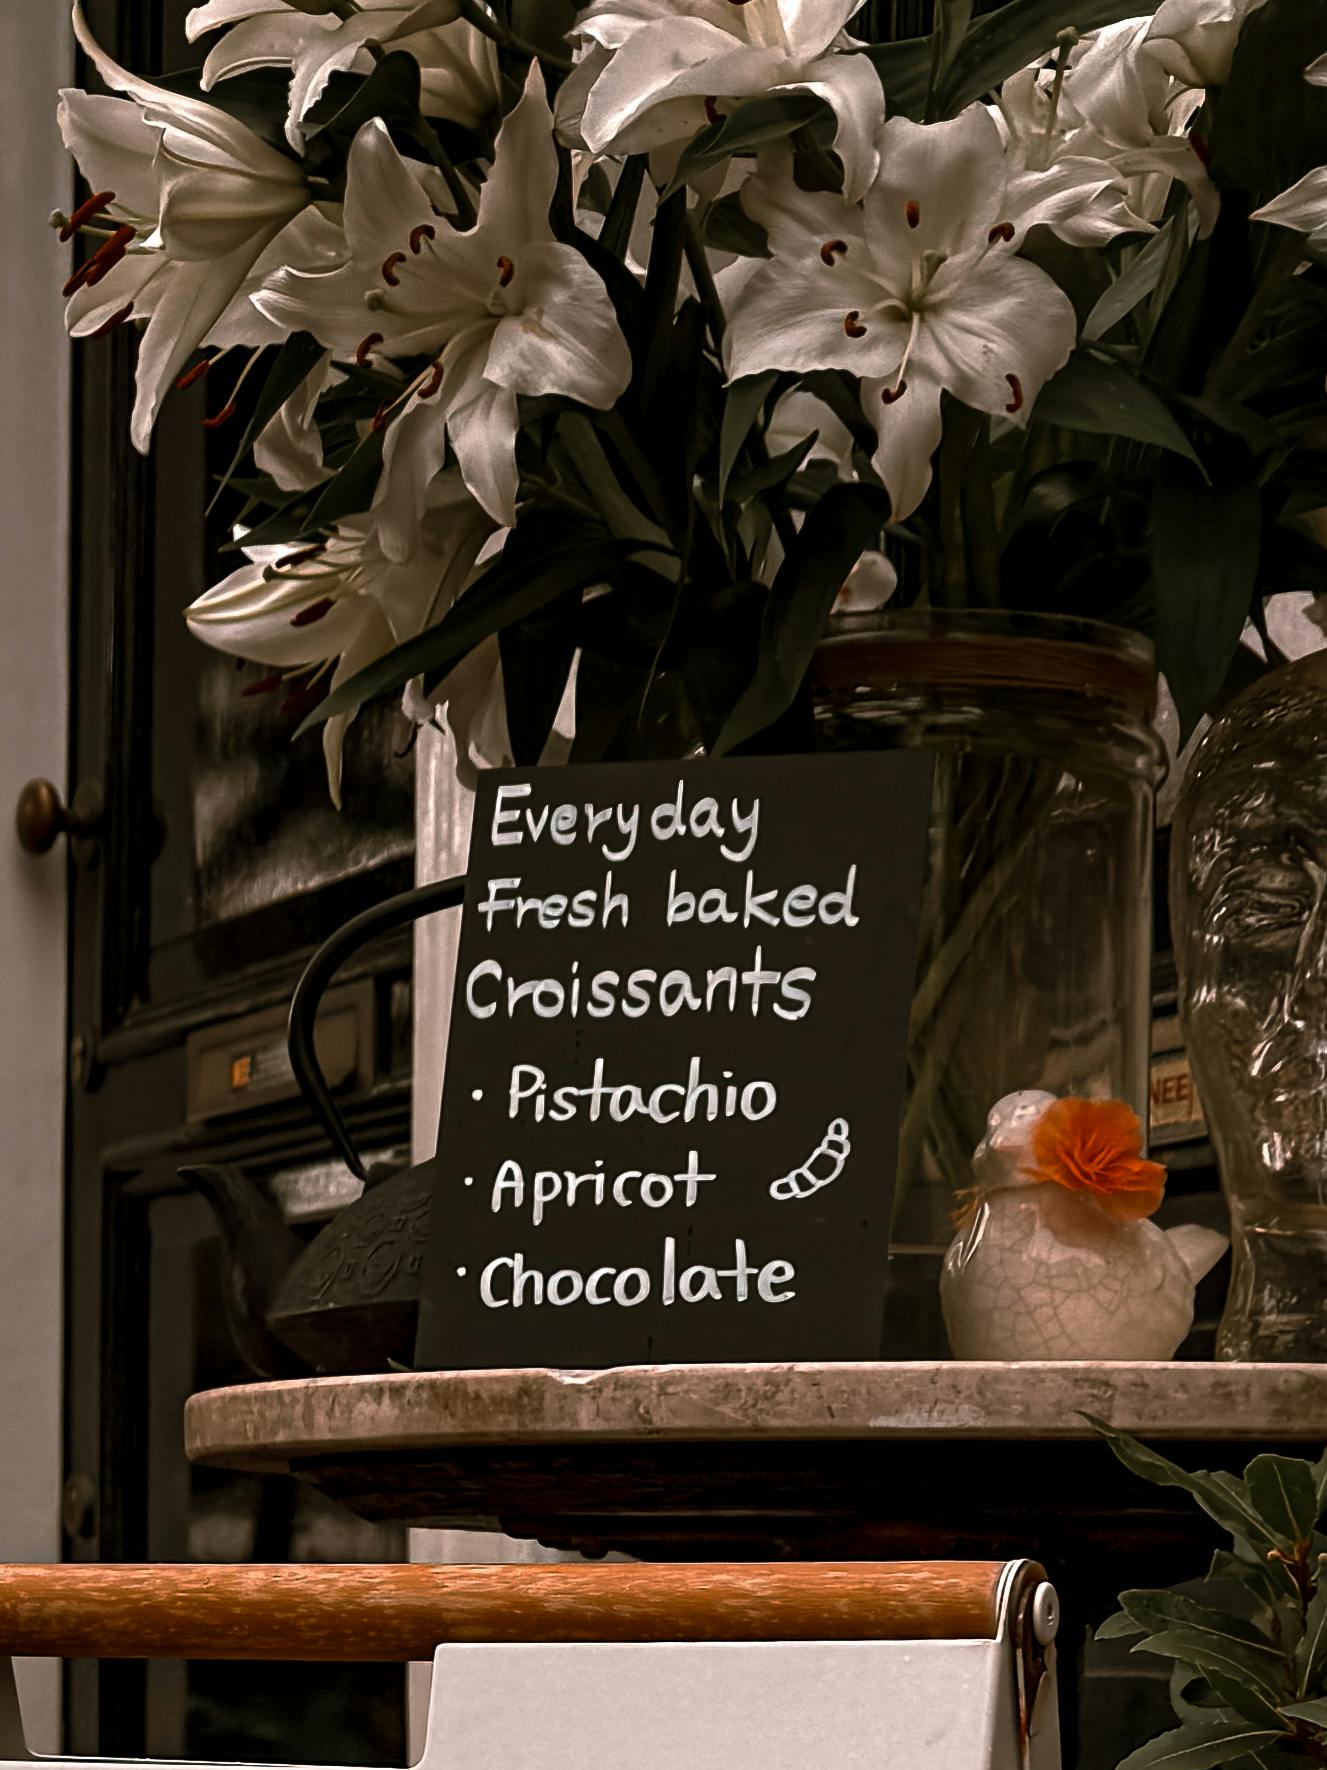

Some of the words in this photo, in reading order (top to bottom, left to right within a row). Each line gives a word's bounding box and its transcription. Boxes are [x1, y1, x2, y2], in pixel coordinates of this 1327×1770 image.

[488, 777, 762, 865] Everyday
[475, 868, 631, 935] Fresh
[664, 857, 862, 931] baked
[463, 942, 819, 1023] Croissants
[506, 1054, 779, 1126] Pistachio
[489, 1148, 719, 1229] Apricot
[477, 1234, 798, 1310] Chocolate
